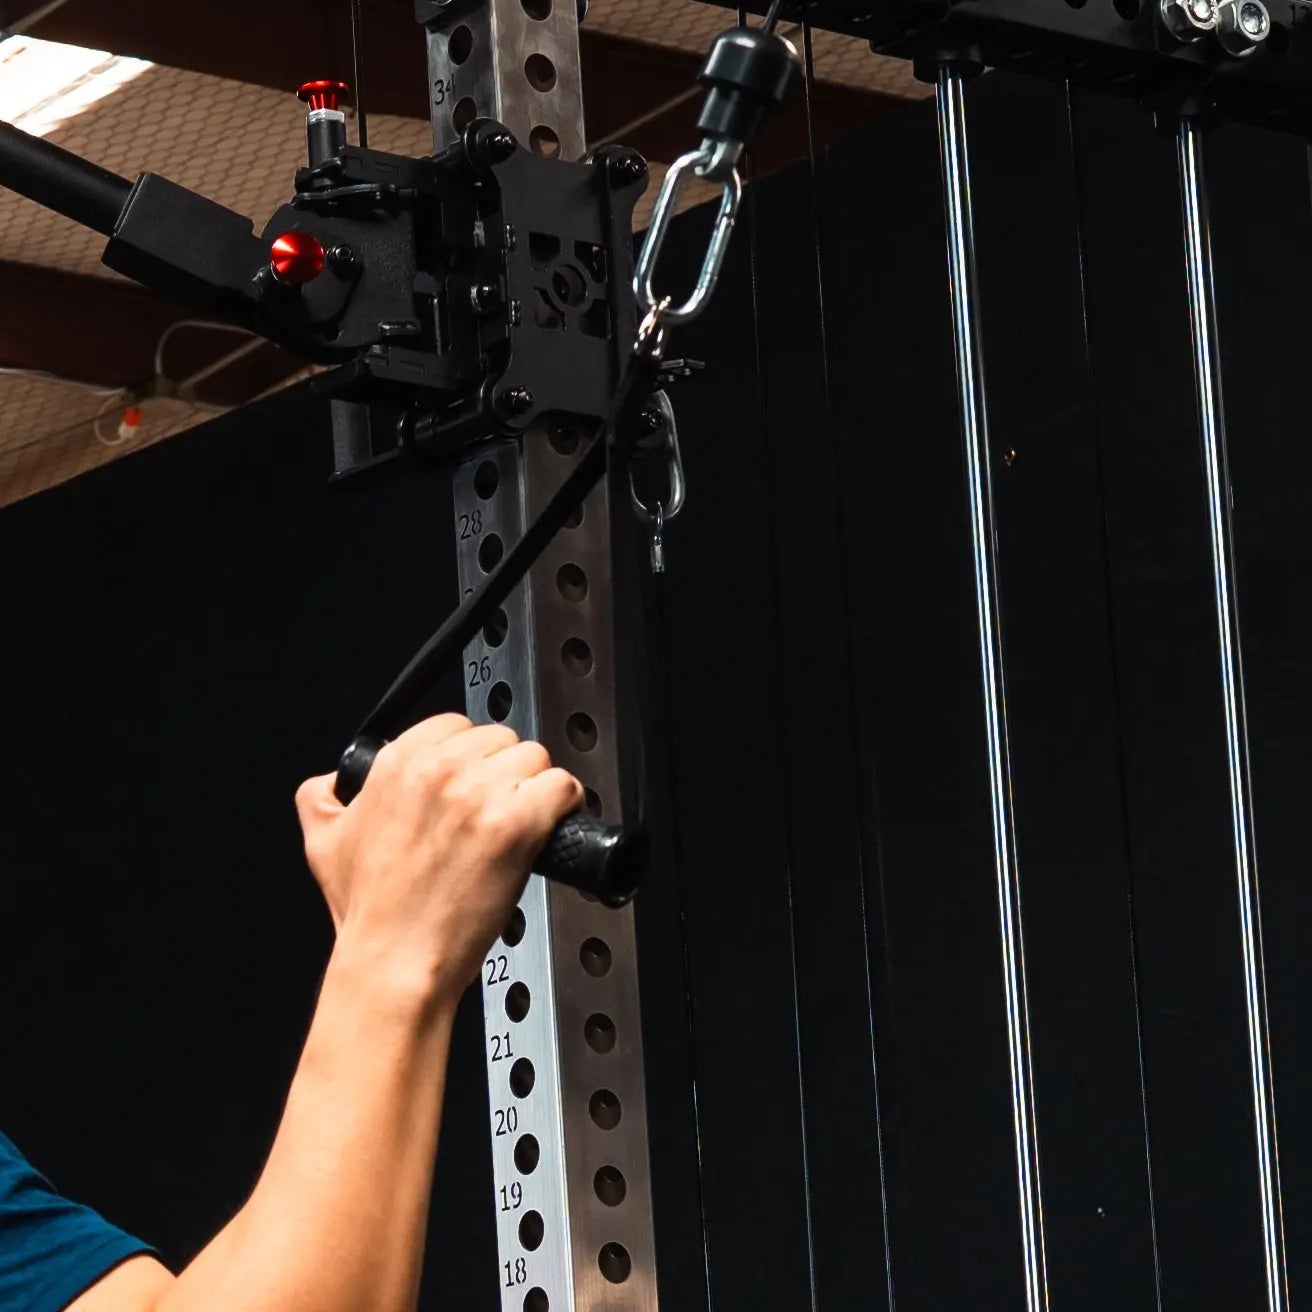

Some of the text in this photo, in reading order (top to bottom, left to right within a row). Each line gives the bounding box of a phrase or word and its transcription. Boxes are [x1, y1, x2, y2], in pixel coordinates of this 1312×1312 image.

[434, 73, 456, 105] 34
[459, 508, 483, 542] 28
[469, 655, 492, 688] 26
[486, 956, 509, 986] 22
[490, 1032, 513, 1063] 21
[495, 1106, 518, 1136] 20
[500, 1181, 522, 1212] 19
[505, 1257, 527, 1288] 18
